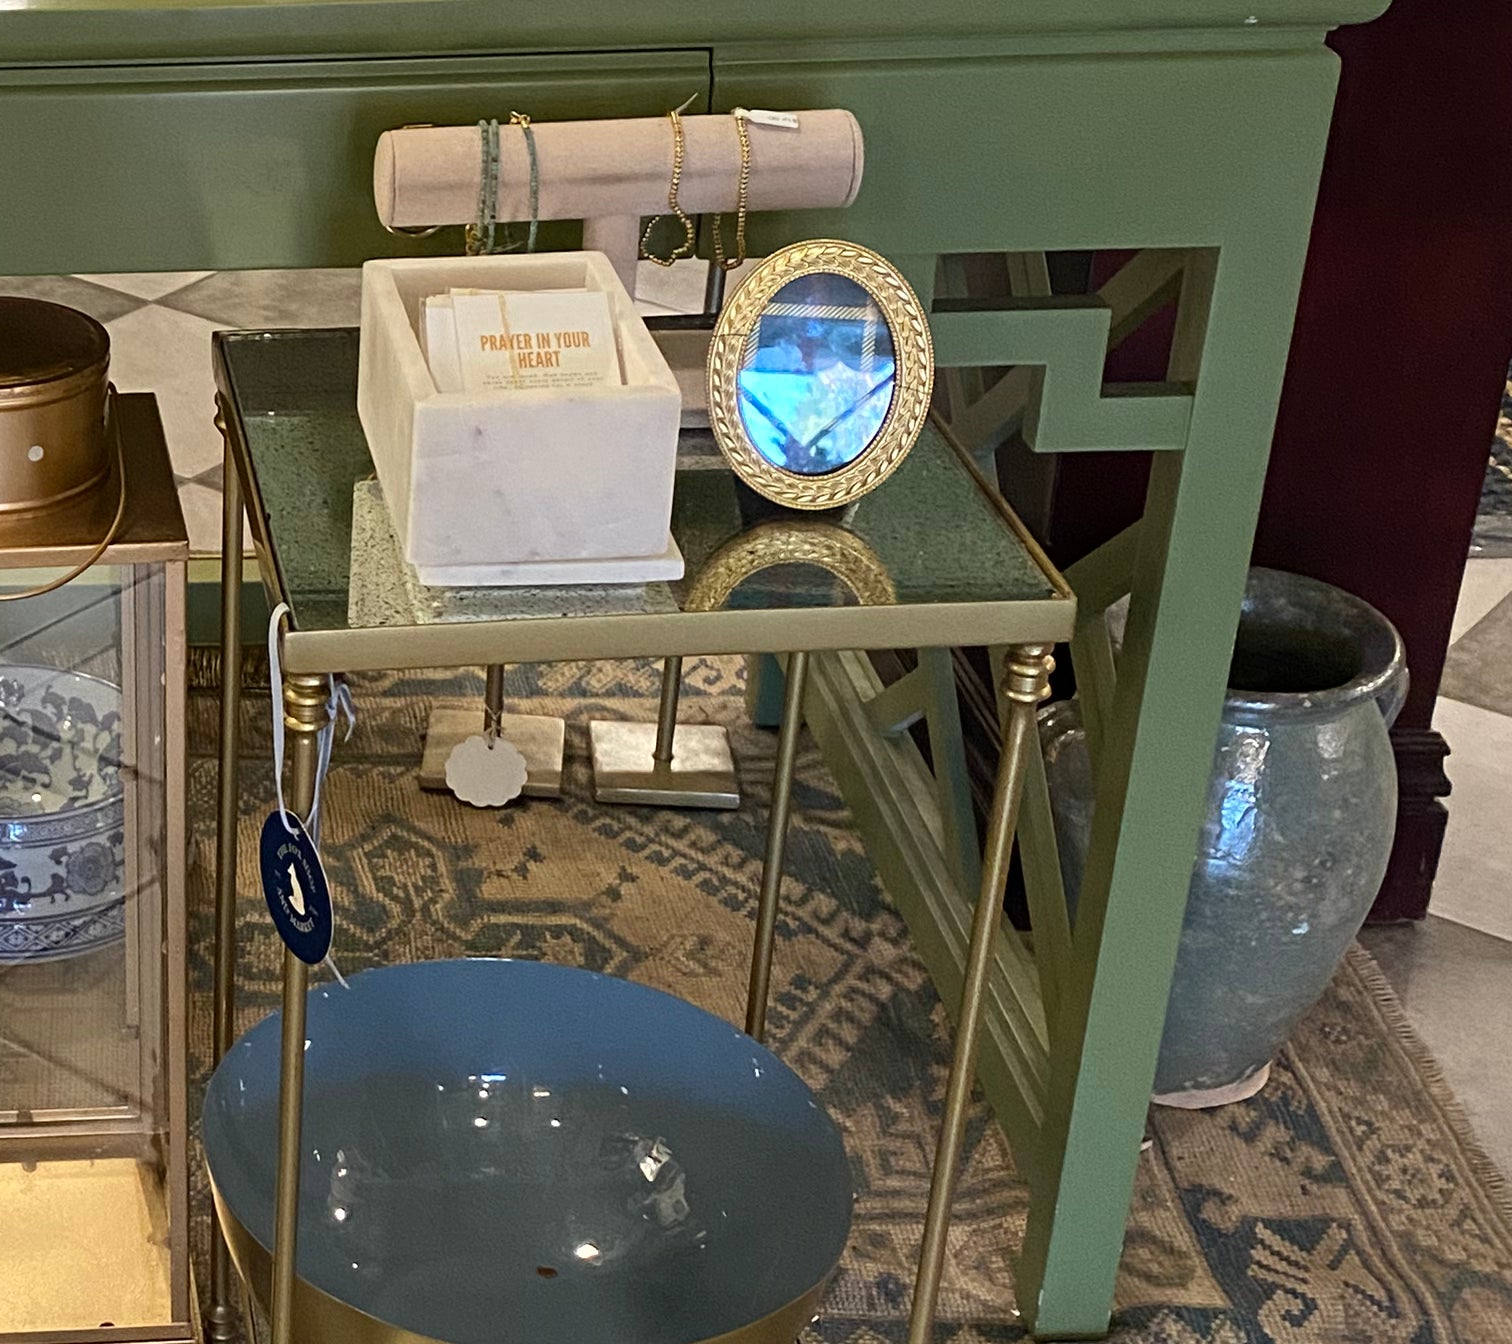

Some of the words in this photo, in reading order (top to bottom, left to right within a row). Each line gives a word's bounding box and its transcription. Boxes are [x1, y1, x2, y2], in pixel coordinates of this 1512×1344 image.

[480, 333, 533, 352] PRAYER
[536, 332, 551, 350] IN
[553, 331, 591, 349] YOUR
[517, 350, 561, 369] HEART
